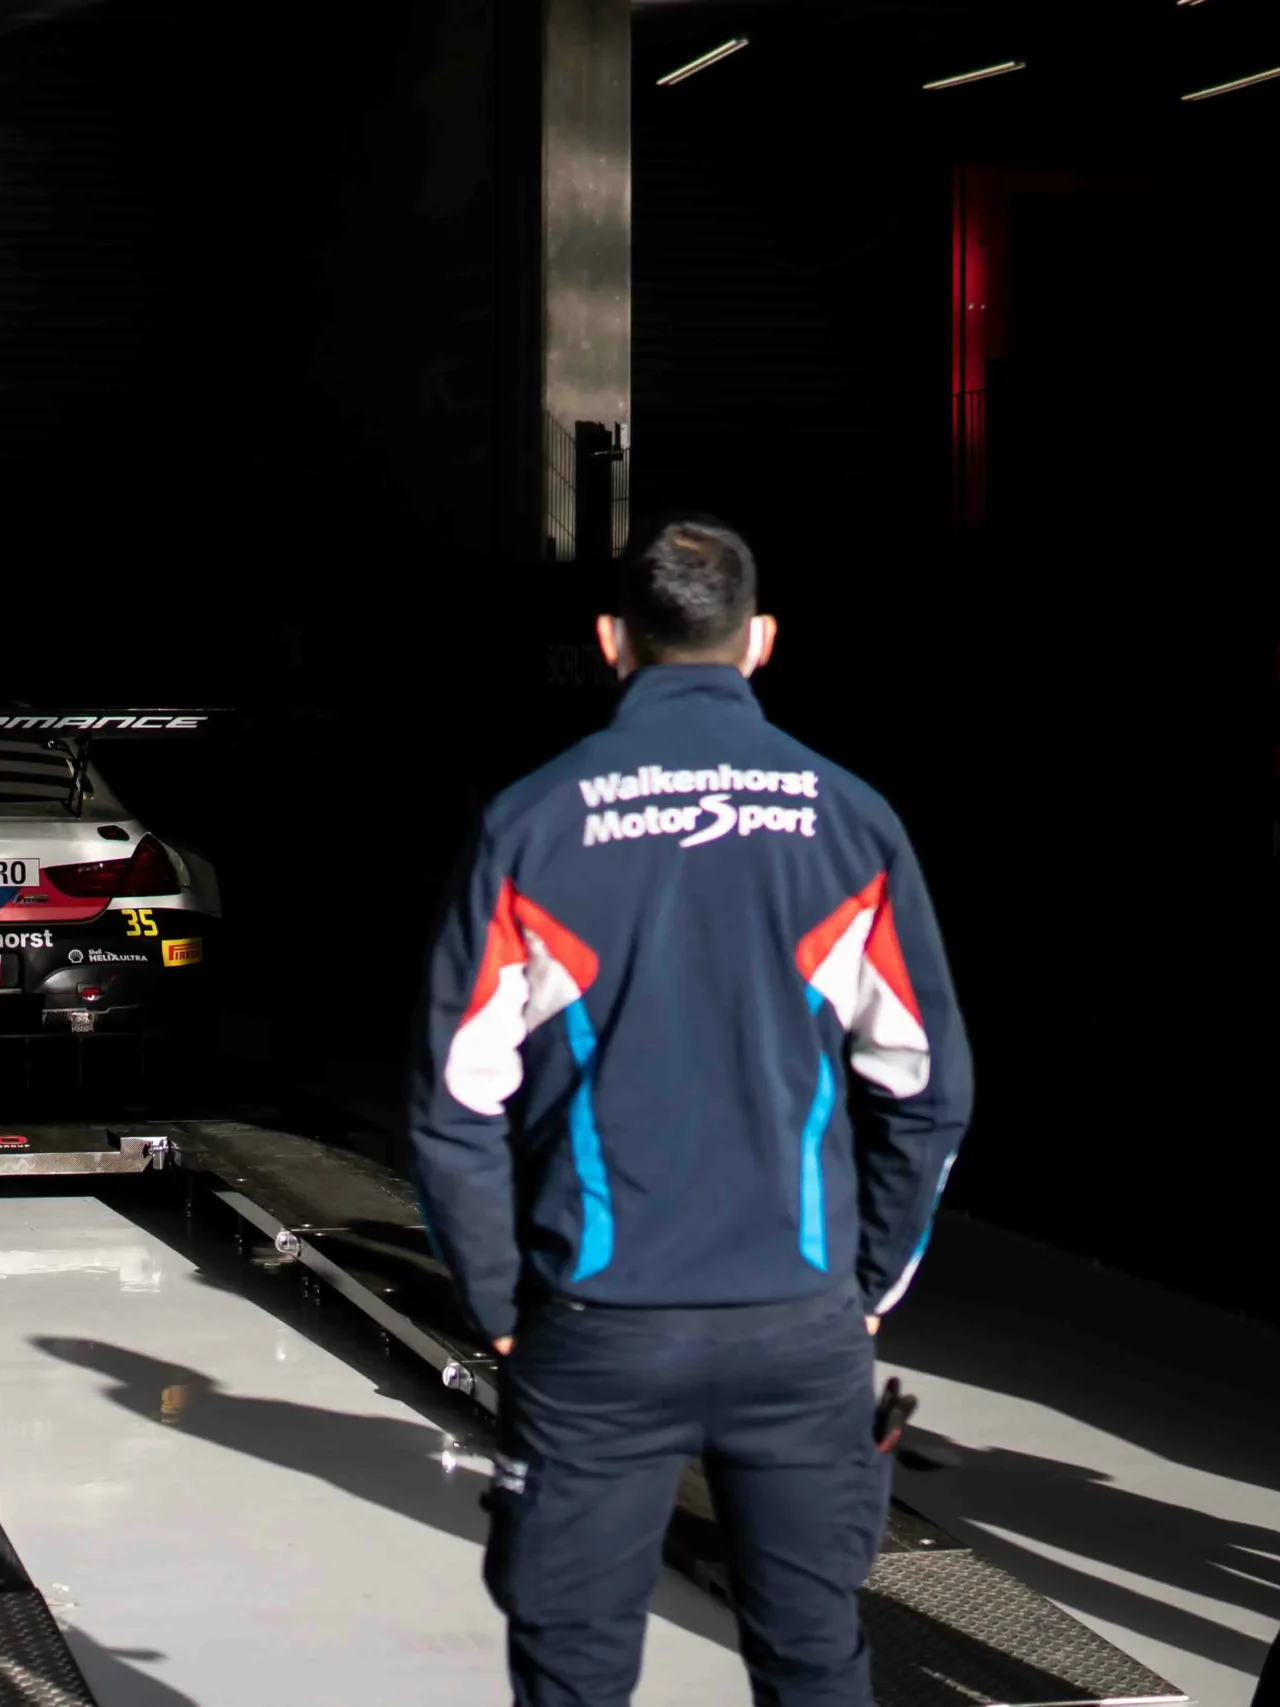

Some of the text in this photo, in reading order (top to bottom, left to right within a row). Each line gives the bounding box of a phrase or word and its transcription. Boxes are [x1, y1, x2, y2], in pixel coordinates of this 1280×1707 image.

[579, 763, 818, 807] Walkenhorst
[121, 909, 158, 936] 35
[119, 954, 148, 962] ULTRA
